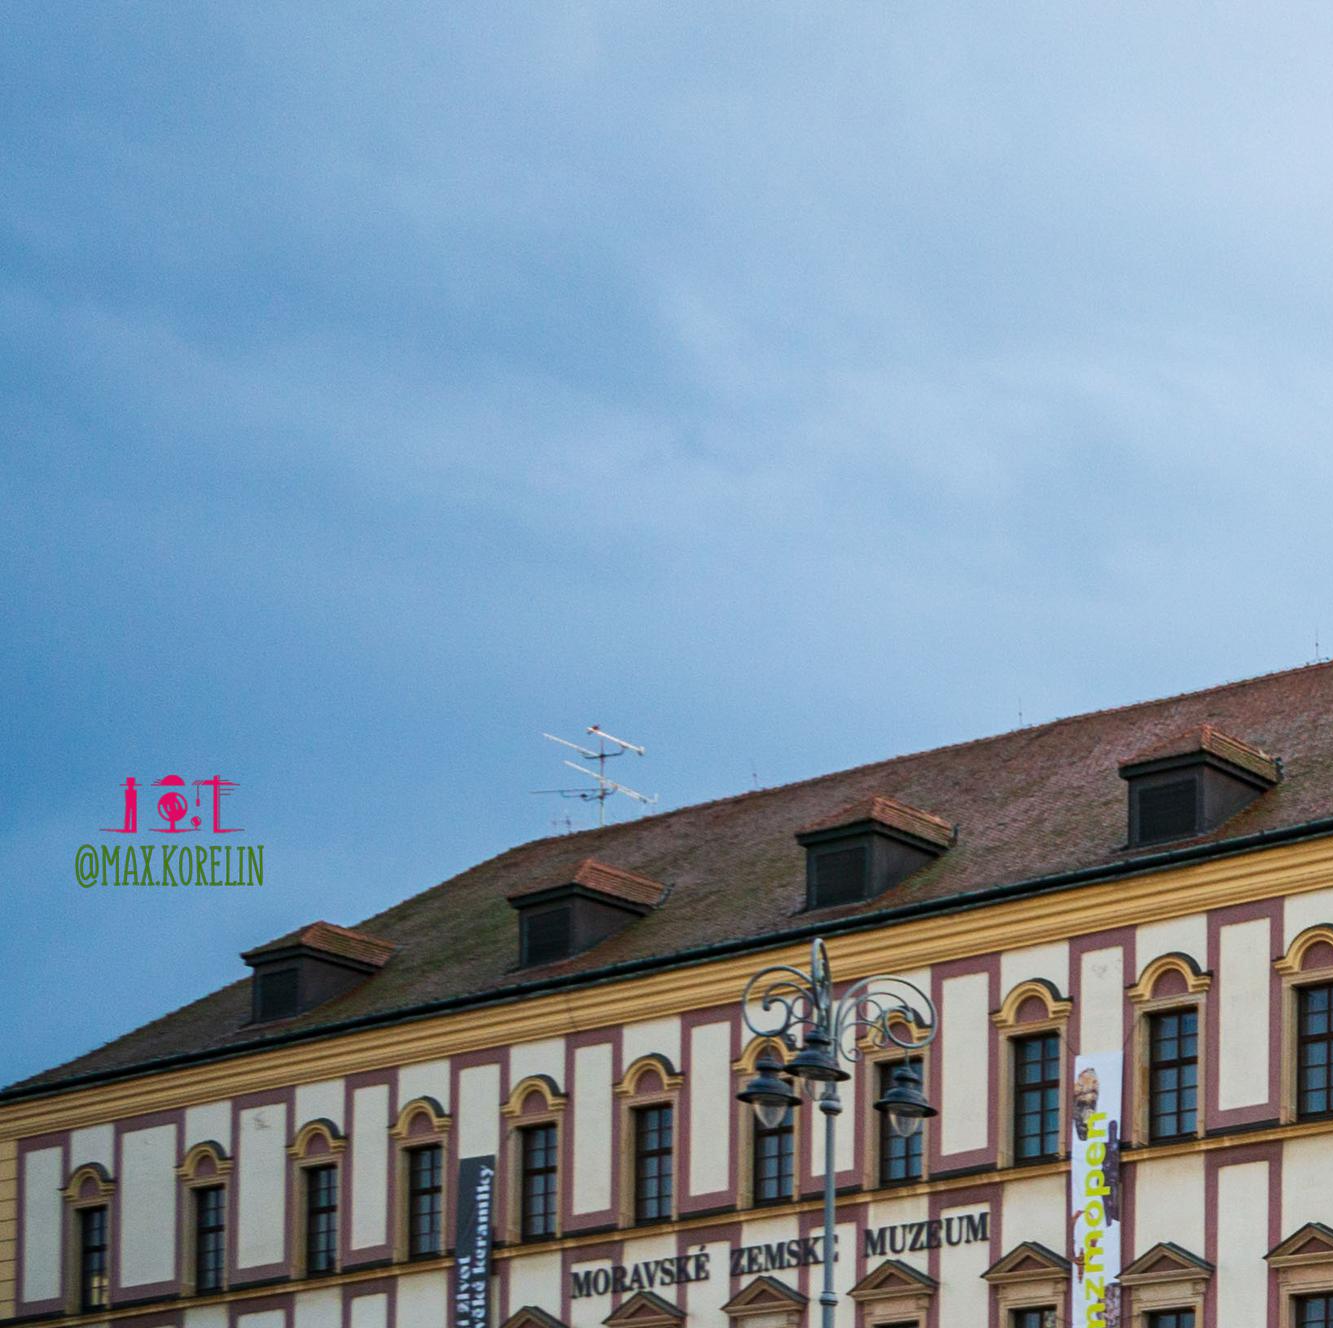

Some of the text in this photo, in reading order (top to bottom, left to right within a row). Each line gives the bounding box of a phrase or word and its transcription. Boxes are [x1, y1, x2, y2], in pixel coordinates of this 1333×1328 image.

[472, 1165, 494, 1275] keramiky
[570, 1211, 991, 1300] MORAVSKÉ ZEMSK MUZEUM
